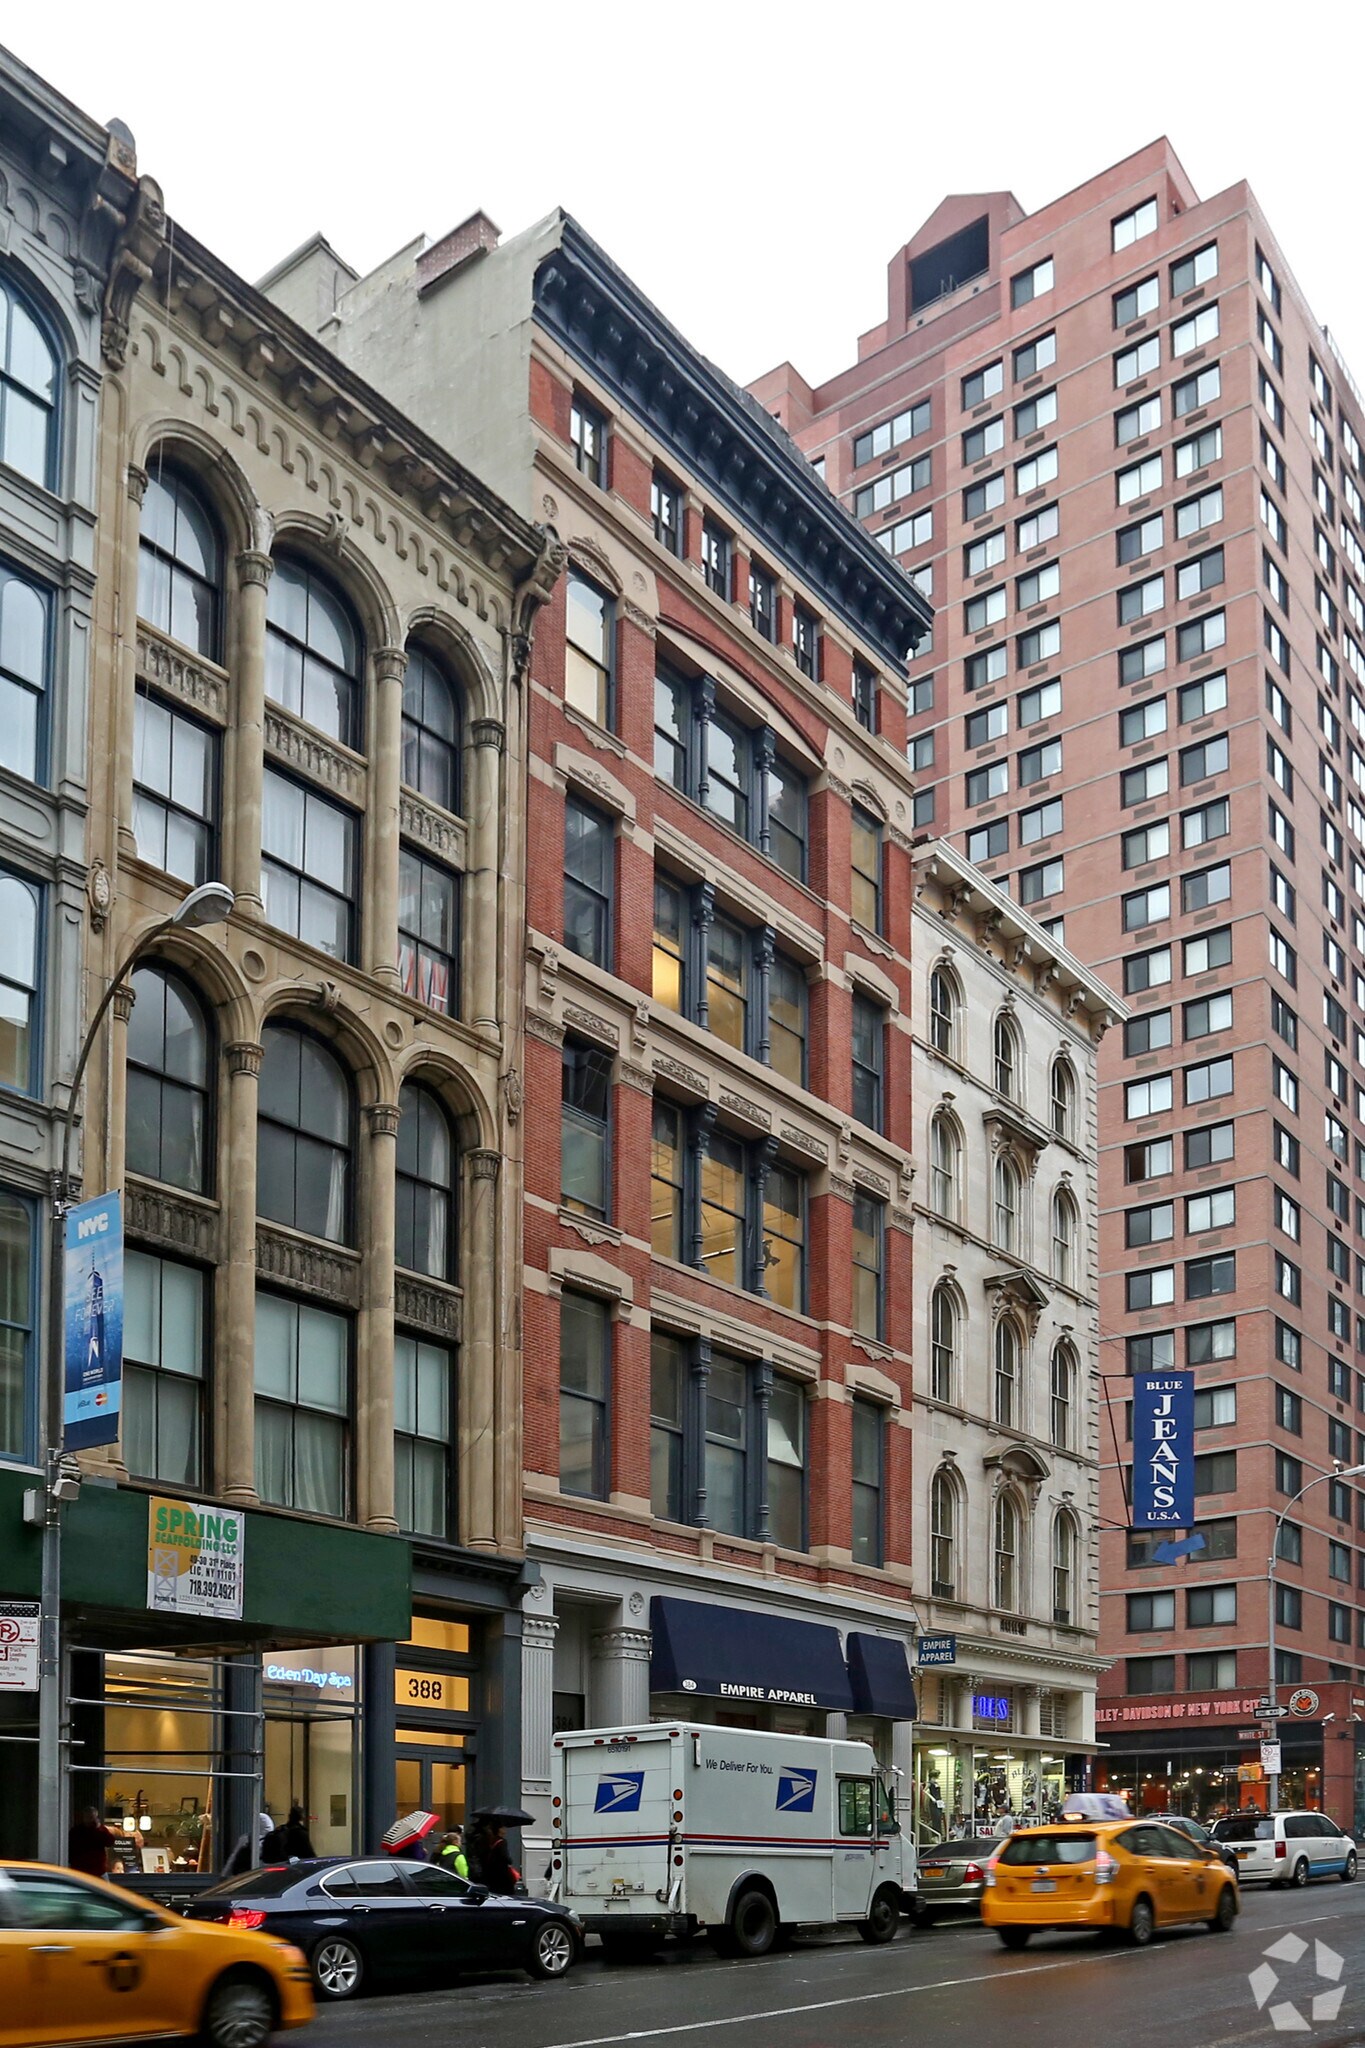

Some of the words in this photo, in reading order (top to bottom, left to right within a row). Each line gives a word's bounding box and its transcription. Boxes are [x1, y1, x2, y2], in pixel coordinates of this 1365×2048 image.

[78, 1212, 108, 1239] NYC
[86, 1285, 103, 1302] SEE
[1146, 1380, 1183, 1390] BLUE
[1149, 1394, 1180, 1509] JEANS
[156, 1506, 238, 1543] SPRING
[1147, 1511, 1181, 1521] U.S.A
[155, 1531, 220, 1552] SCAFFOLDING
[221, 1542, 237, 1556] LLC
[220, 1559, 236, 1570] Place
[206, 1567, 215, 1577] NY
[217, 1569, 236, 1581] 11101
[189, 1579, 236, 1600] 718.392.4921
[922, 1640, 951, 1651] EMPIRE
[920, 1652, 953, 1662] APPAREL
[267, 1664, 301, 1681] Eden
[301, 1668, 328, 1687] Day
[328, 1672, 352, 1688] Spa
[408, 1678, 442, 1700] 388
[720, 1683, 765, 1699] EMPIRE
[767, 1689, 817, 1704] APPAREL
[1172, 1704, 1186, 1718] OF
[1187, 1702, 1211, 1717] NEW
[1213, 1700, 1241, 1715] YORK
[1239, 1731, 1255, 1740] WHITE
[1257, 1730, 1265, 1738] ST
[705, 1759, 717, 1770] We
[719, 1760, 745, 1772] Deliver
[746, 1762, 759, 1773] For
[760, 1763, 774, 1774] You.
